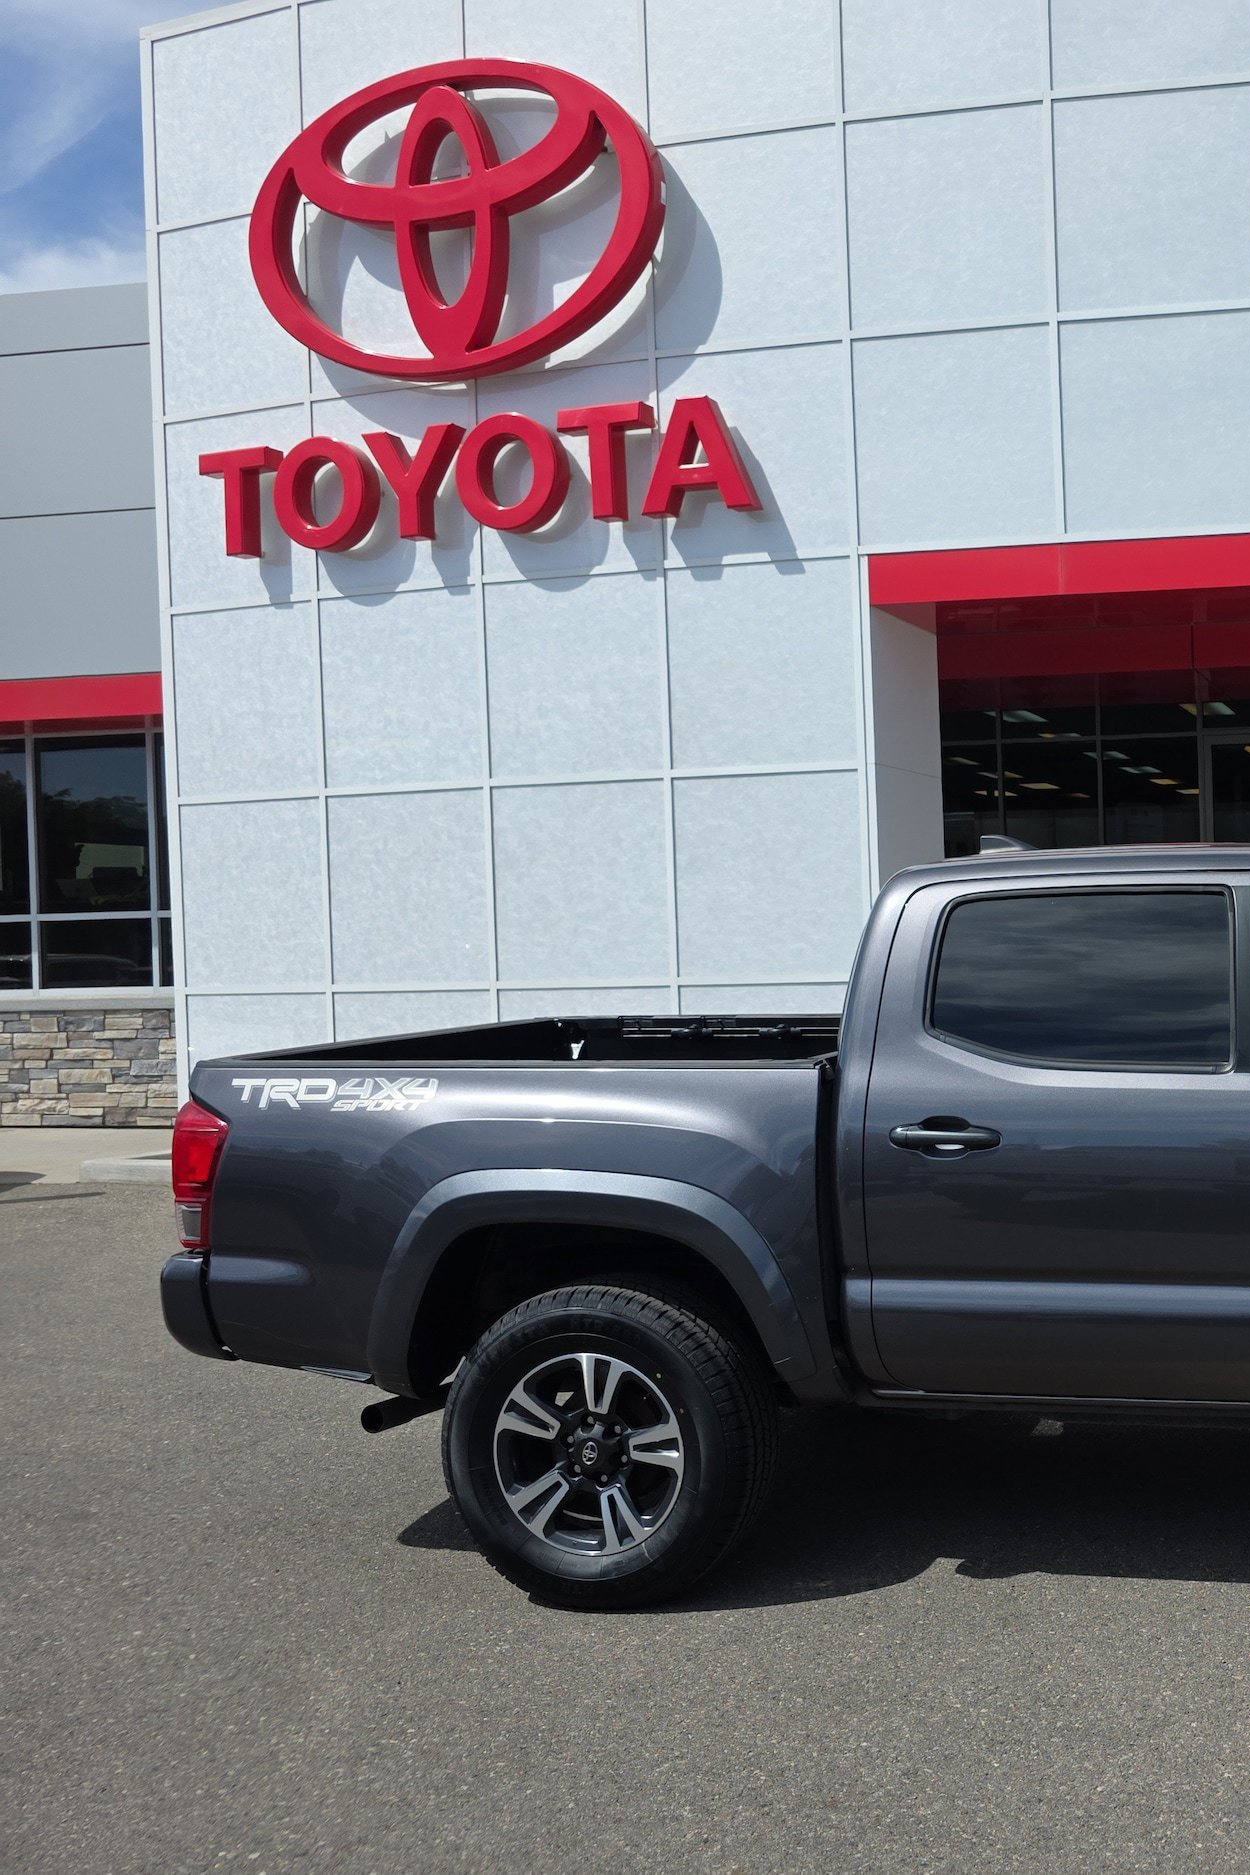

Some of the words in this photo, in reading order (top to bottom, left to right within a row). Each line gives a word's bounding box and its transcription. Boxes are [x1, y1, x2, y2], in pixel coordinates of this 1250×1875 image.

[198, 394, 764, 560] TOYOTA
[231, 1078, 339, 1111] TRD
[330, 1099, 431, 1112] SPORT
